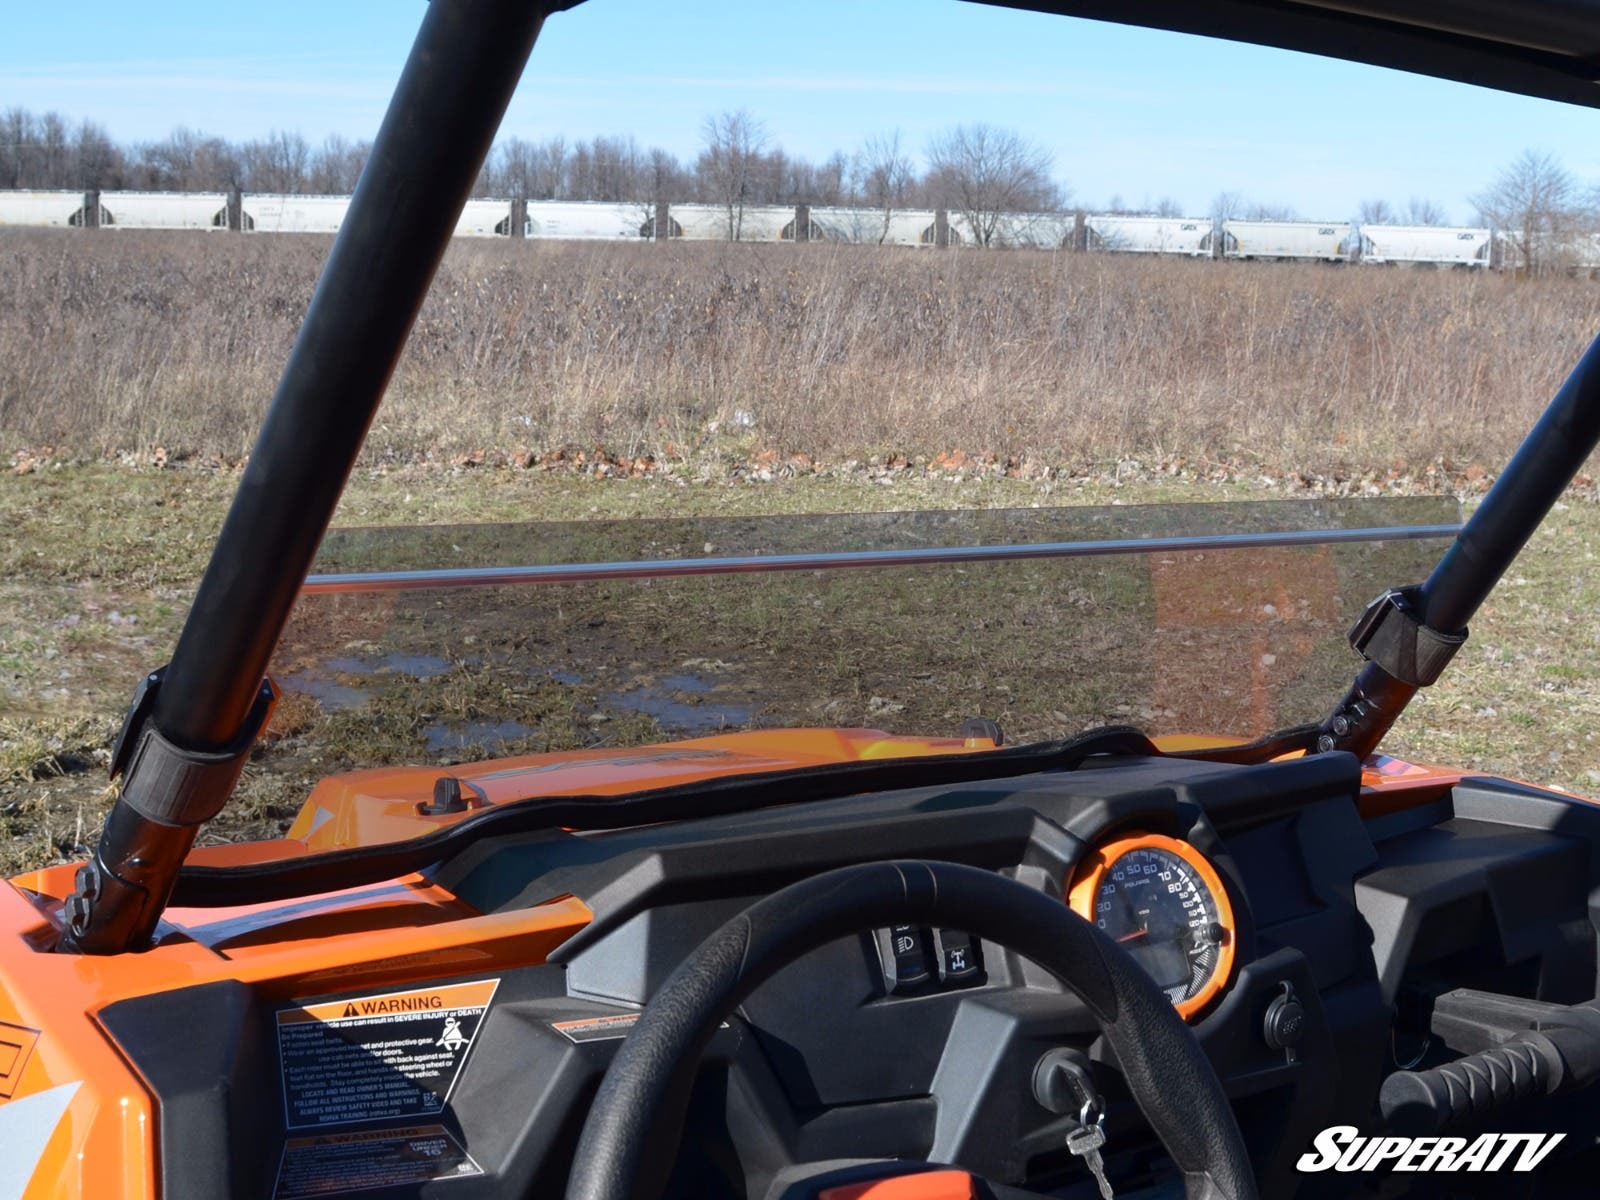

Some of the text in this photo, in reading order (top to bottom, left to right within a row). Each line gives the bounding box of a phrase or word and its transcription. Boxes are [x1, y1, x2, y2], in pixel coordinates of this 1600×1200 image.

[1126, 864, 1140, 875] 50
[1143, 864, 1157, 875] 60
[1112, 871, 1124, 881] 40
[1158, 871, 1171, 882] 70
[1102, 884, 1115, 895] 30
[1168, 882, 1182, 894] 80
[1097, 901, 1111, 912] 20
[362, 996, 442, 1014] WARNING
[367, 1017, 386, 1025] result
[394, 1013, 422, 1023] SEVERE
[423, 1012, 448, 1020] INJURY
[457, 1008, 482, 1017] DEATH
[371, 1041, 384, 1049] and
[384, 1038, 417, 1049] protective
[417, 1037, 434, 1046] gear.
[382, 1048, 404, 1056] doors.
[396, 1055, 413, 1063] back
[413, 1053, 438, 1063] against
[398, 1063, 425, 1072] steering
[425, 1061, 445, 1069] wheel
[415, 1070, 440, 1078] vehicle.
